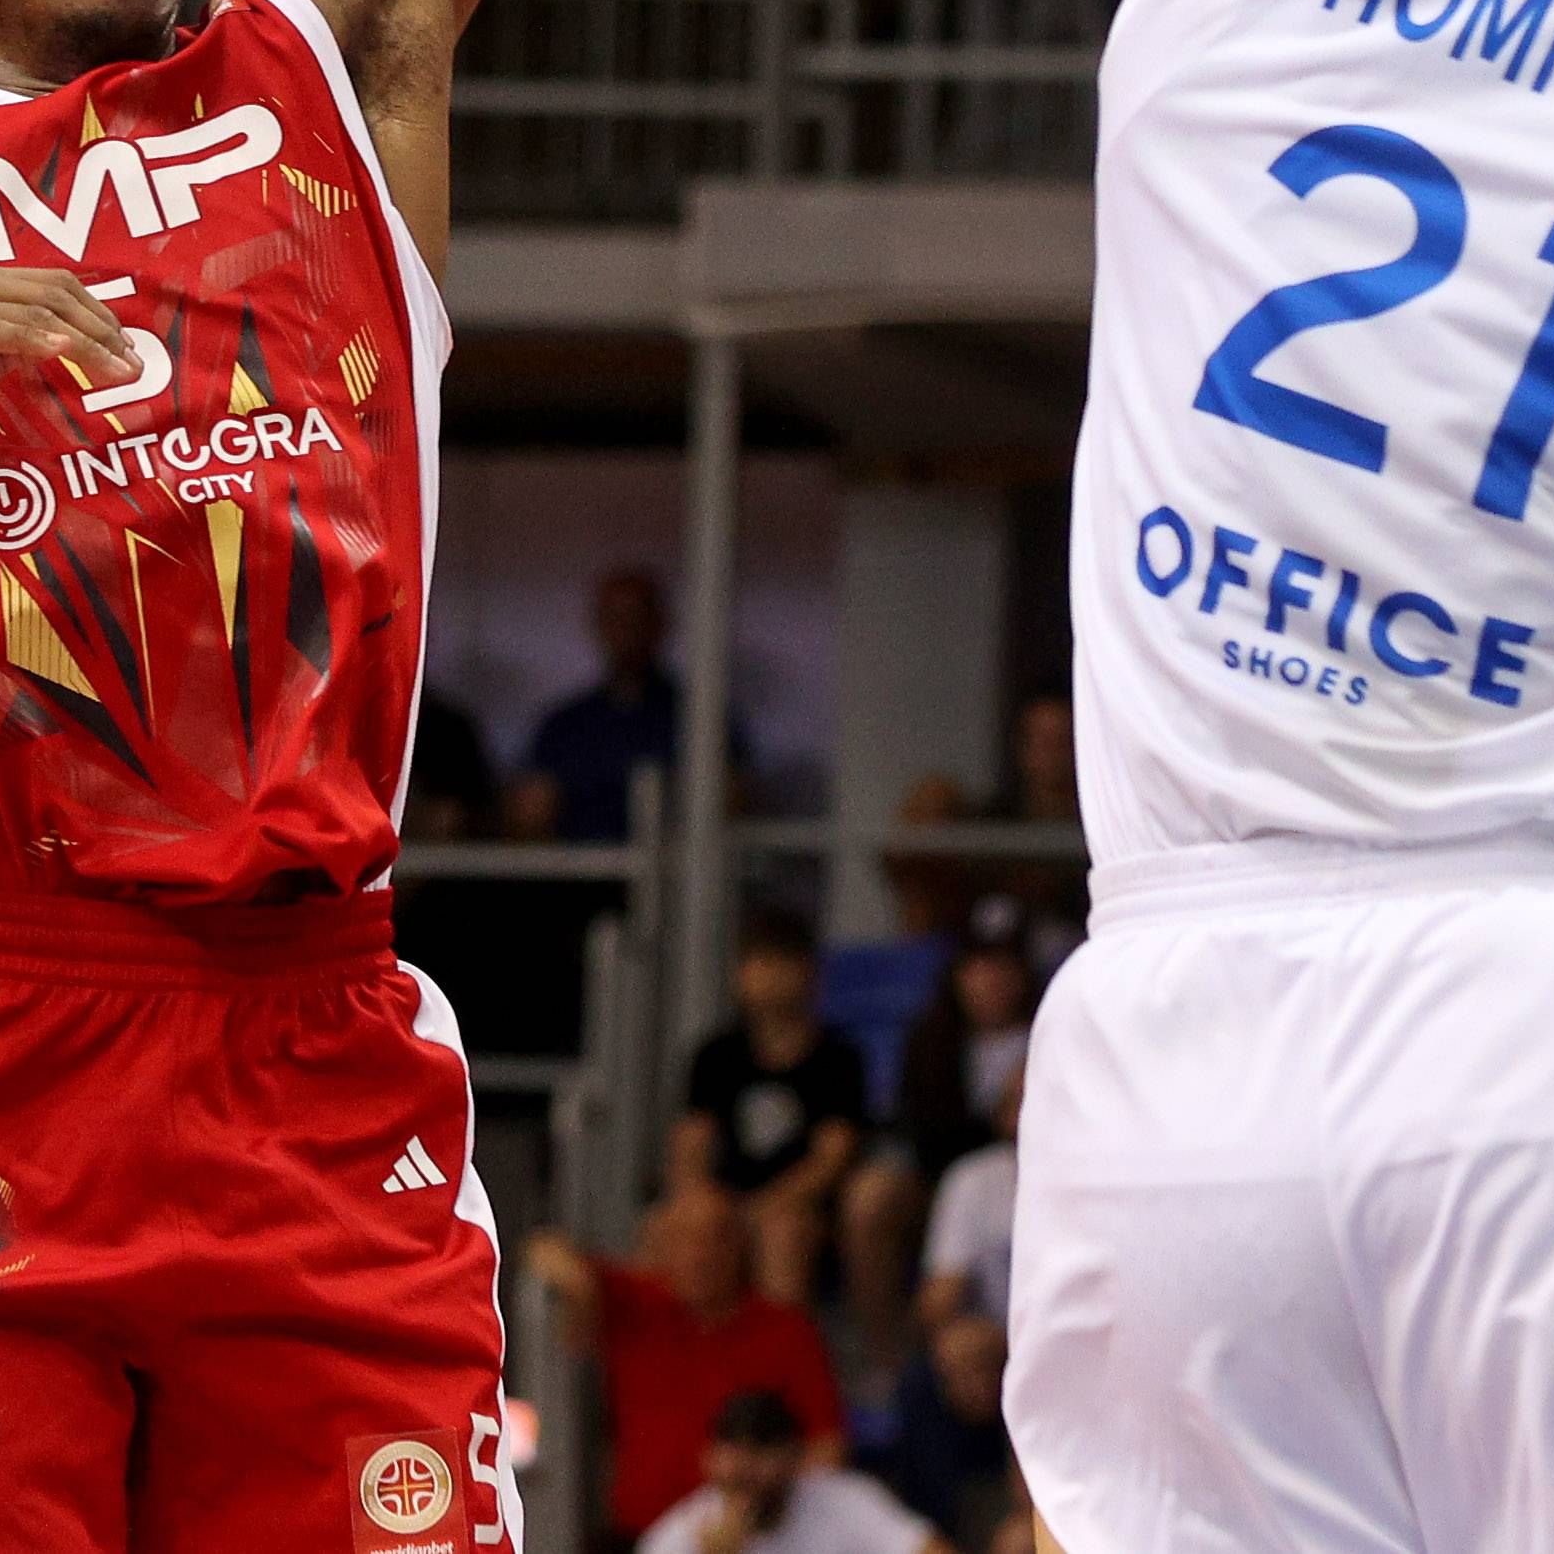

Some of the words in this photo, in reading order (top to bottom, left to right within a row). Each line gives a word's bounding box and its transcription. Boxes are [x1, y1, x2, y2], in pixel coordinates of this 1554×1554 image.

[81, 275, 174, 413] 5
[178, 470, 254, 503] CITY
[1136, 505, 1535, 708] OFFICE
[1223, 640, 1369, 706] SHOES
[468, 1412, 504, 1545] 5
